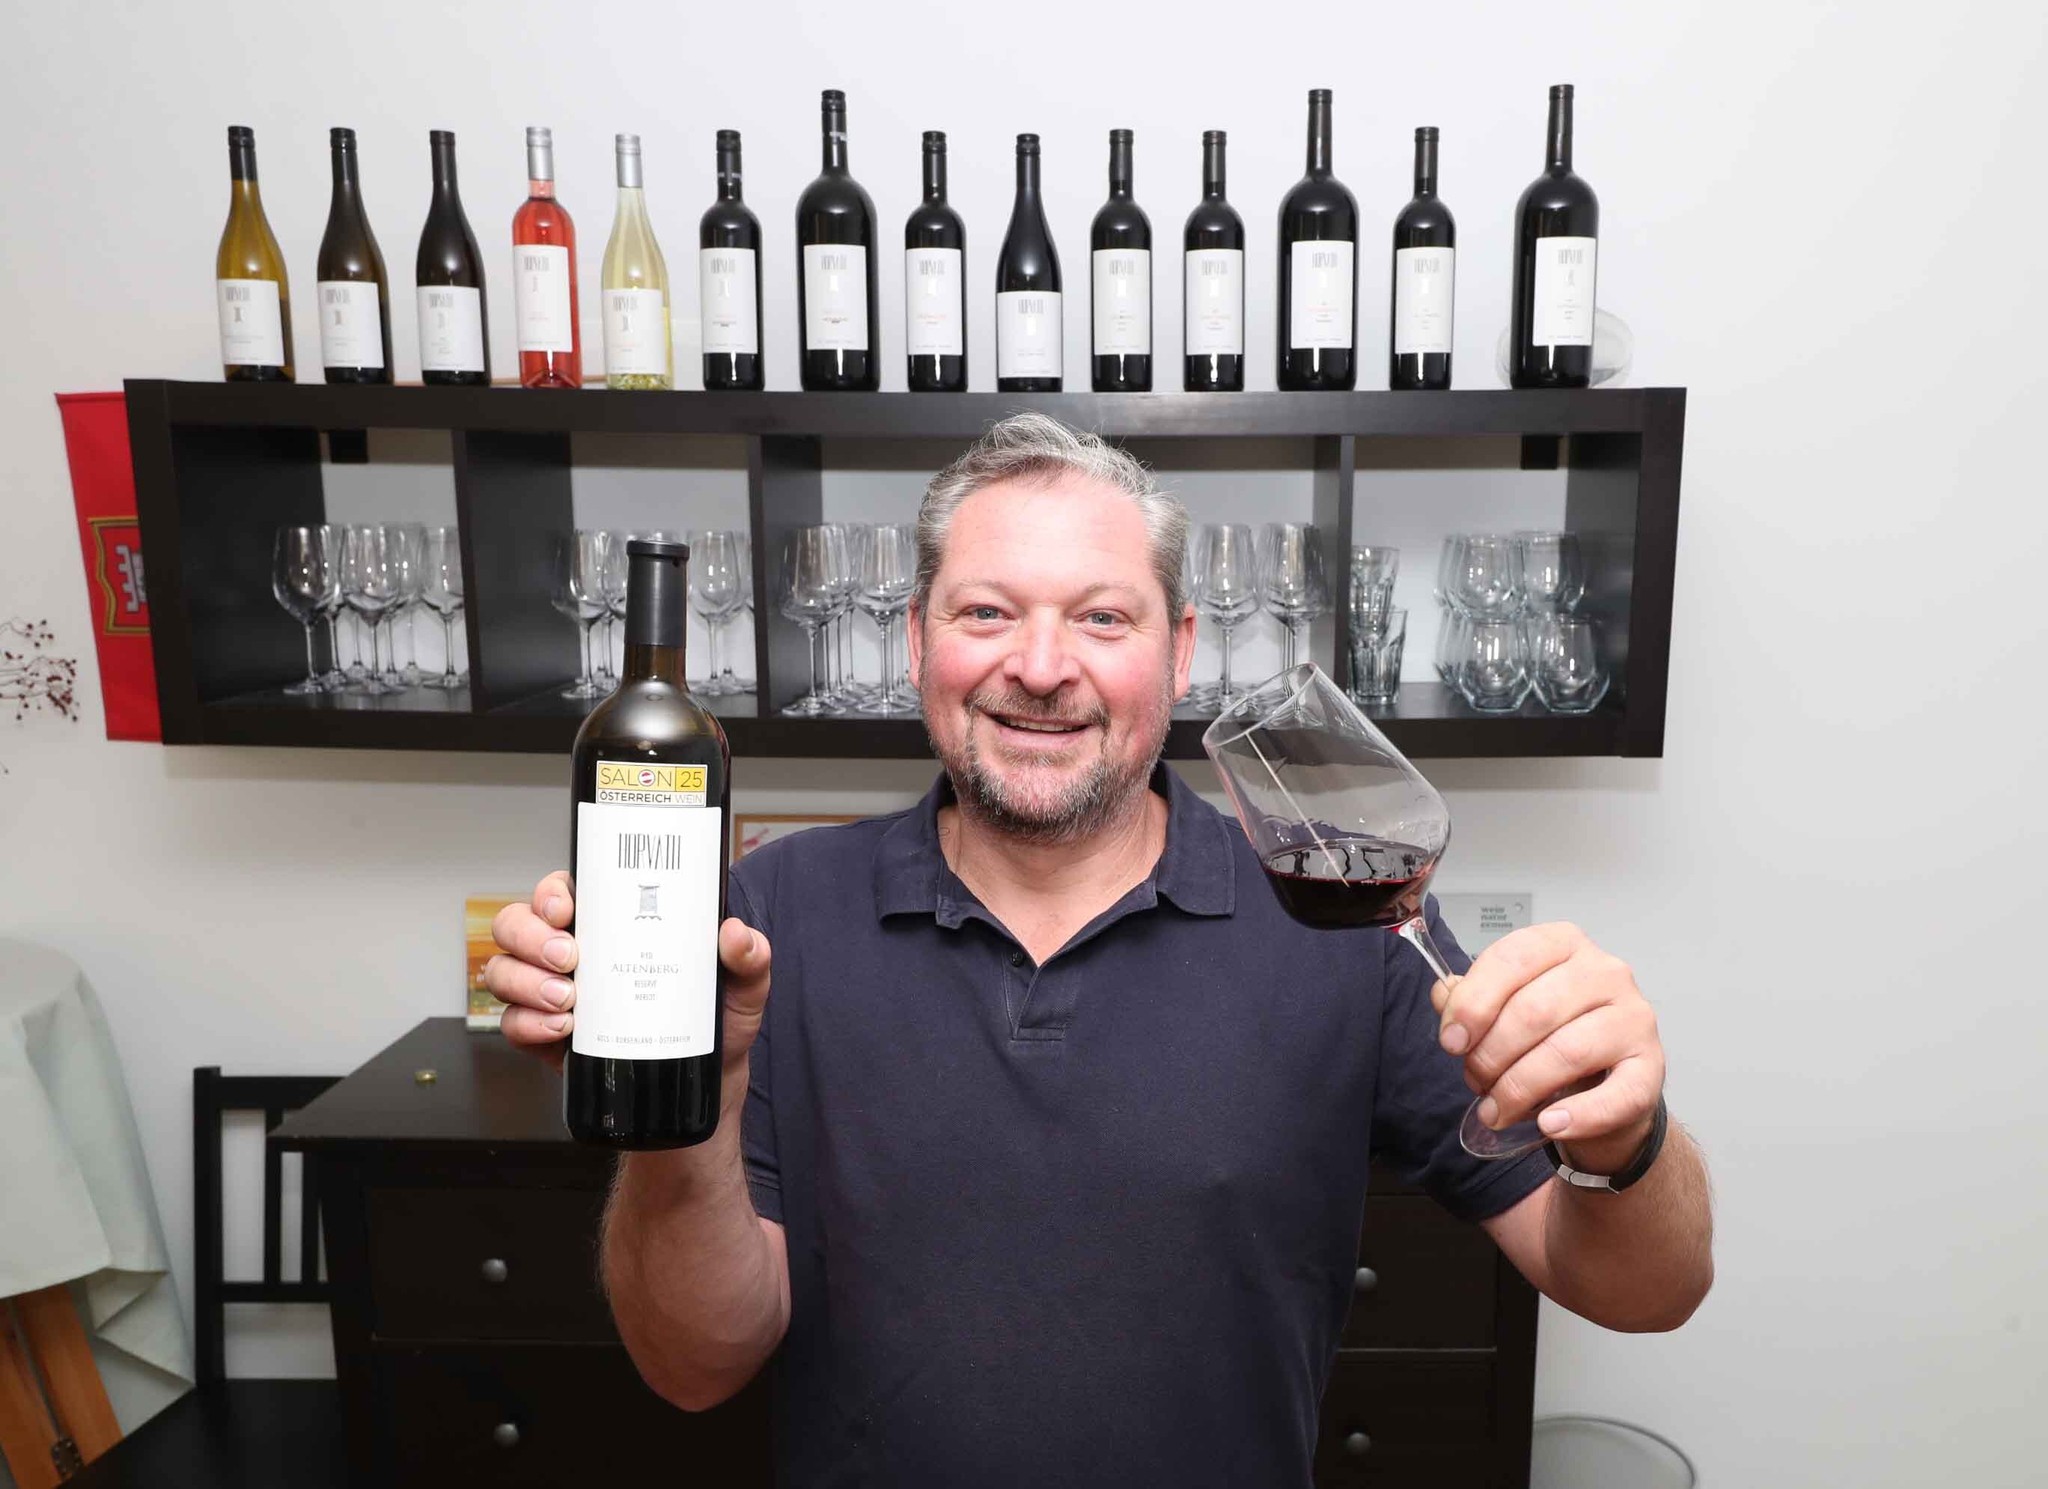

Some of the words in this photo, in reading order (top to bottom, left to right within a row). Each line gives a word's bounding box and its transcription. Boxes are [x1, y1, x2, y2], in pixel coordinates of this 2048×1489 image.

[600, 767, 673, 788] SALON
[680, 770, 703, 789] 25
[600, 790, 672, 804] ÖSTERREICH
[674, 794, 703, 804] WEIN
[618, 832, 681, 870] HORVATH
[610, 963, 679, 975] ALTENBERG
